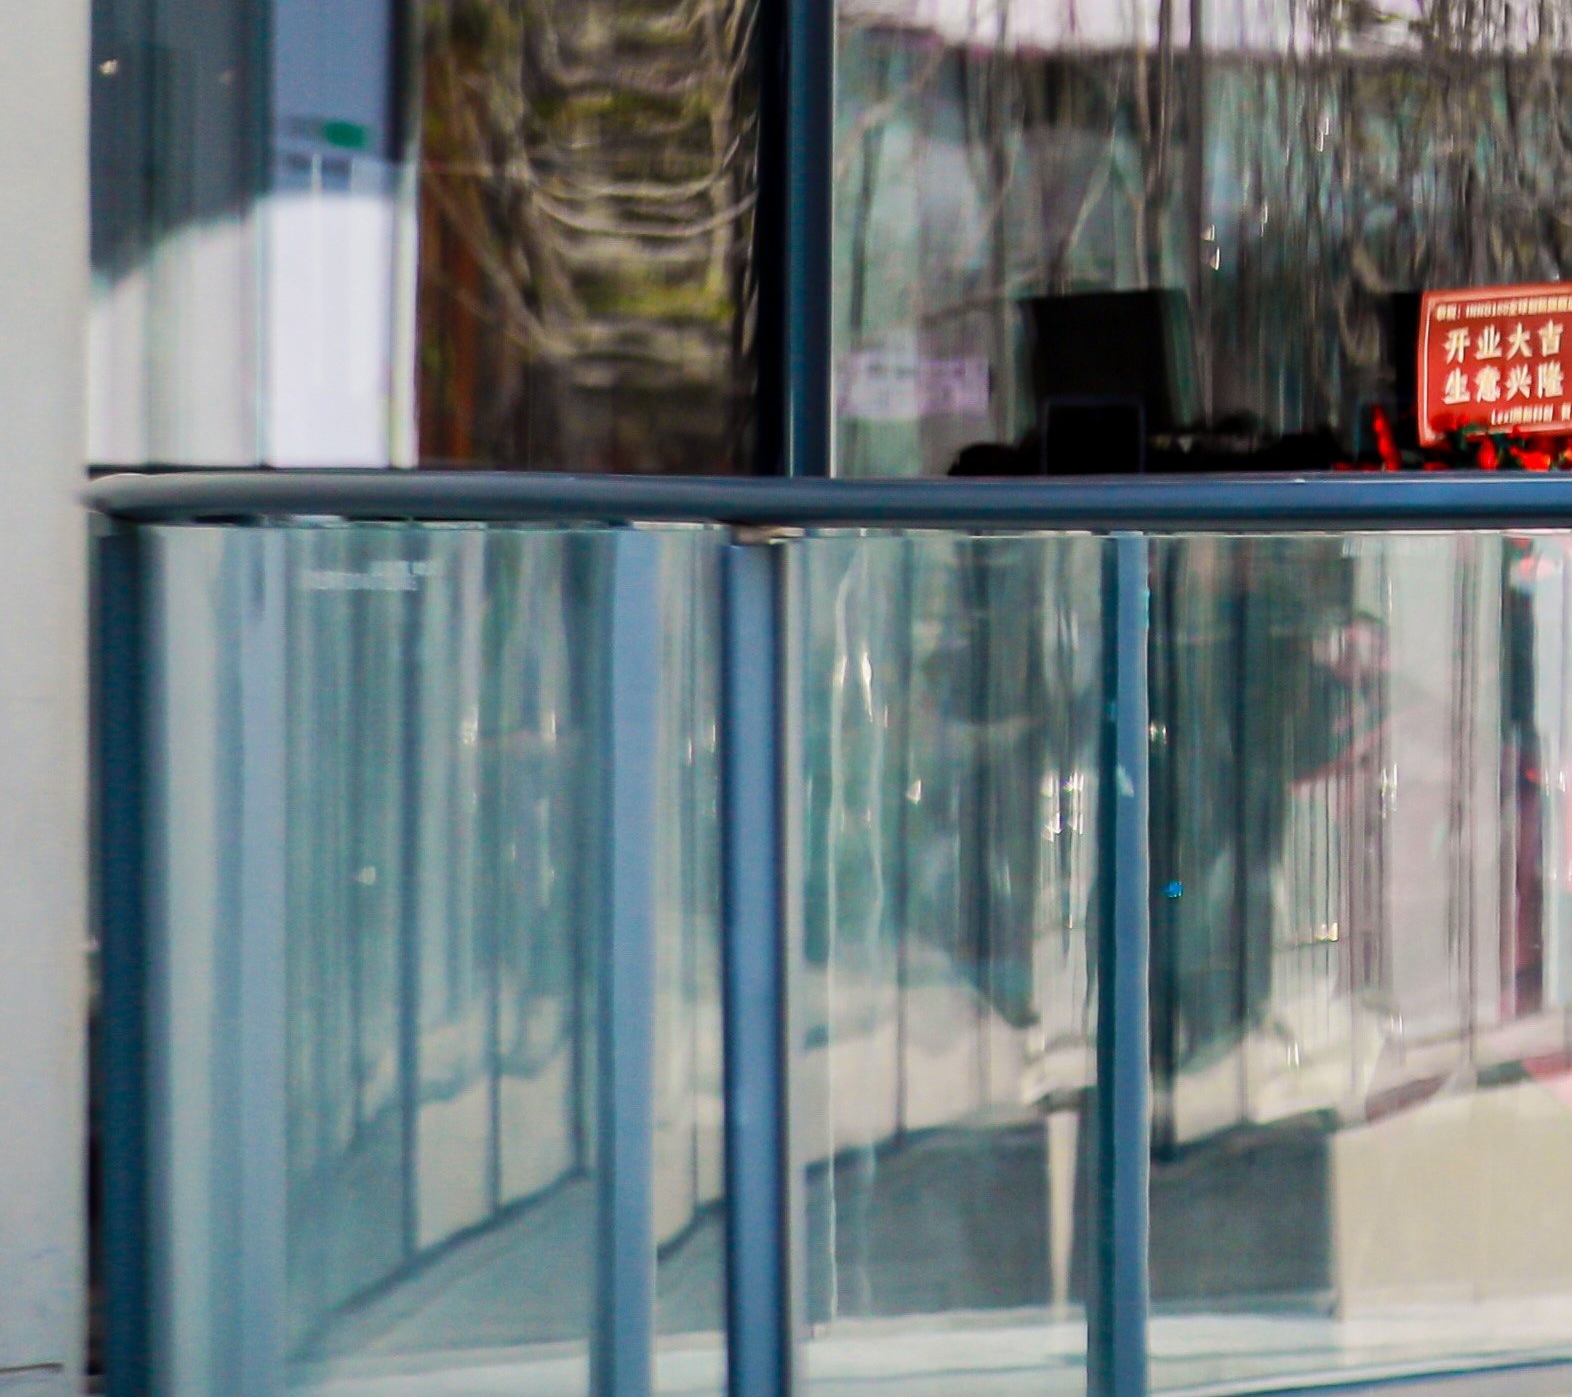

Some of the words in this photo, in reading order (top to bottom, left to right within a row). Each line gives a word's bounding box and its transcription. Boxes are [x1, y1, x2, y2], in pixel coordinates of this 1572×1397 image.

[1443, 318, 1563, 364] 开业大吉
[1442, 360, 1564, 404] 生意兴隆
